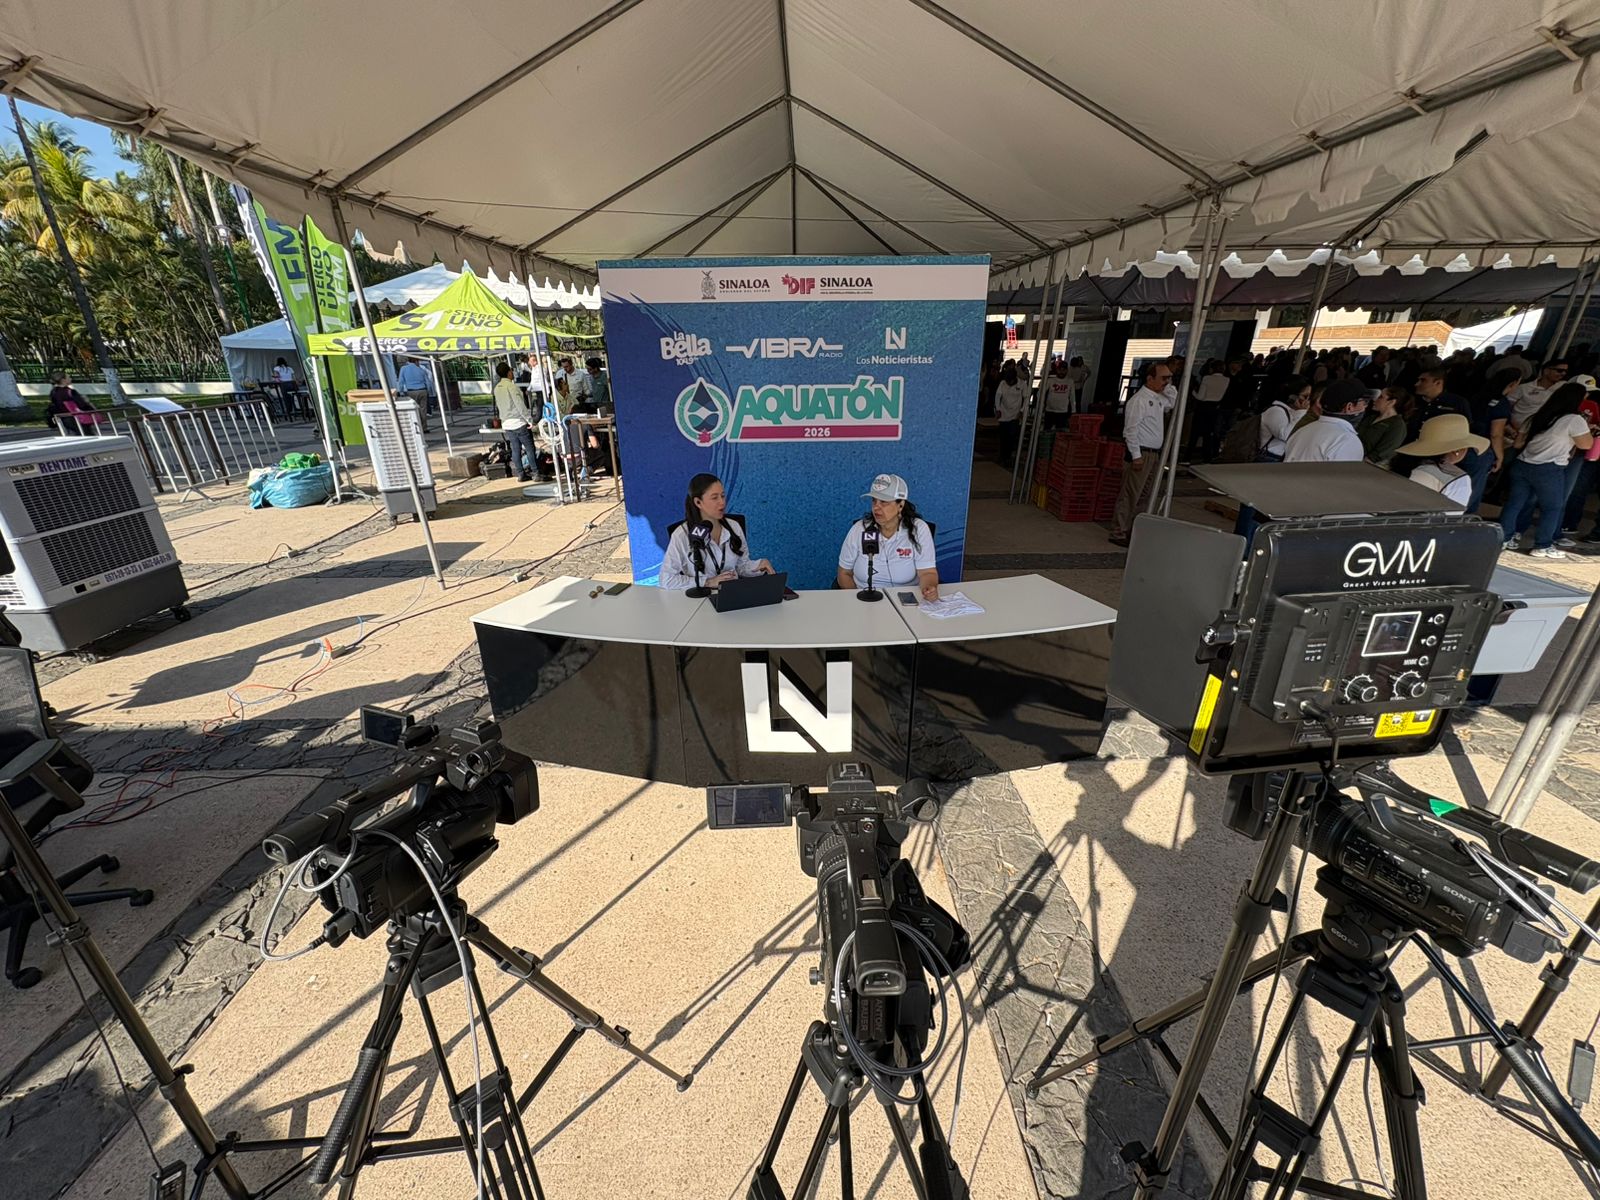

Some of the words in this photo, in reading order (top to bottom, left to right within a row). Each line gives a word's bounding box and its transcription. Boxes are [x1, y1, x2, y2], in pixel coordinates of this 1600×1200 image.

[322, 250, 338, 310] UNO
[719, 279, 770, 289] SINALOA
[787, 277, 816, 295] DIF
[820, 277, 873, 287] SINALOA
[449, 315, 503, 328] UNO
[454, 309, 503, 320] STEREO
[363, 337, 408, 345] SEREO
[660, 333, 712, 360] Bella
[726, 337, 843, 358] VIBRA
[885, 327, 907, 350] LN
[871, 355, 933, 364] Noticieristas
[729, 378, 901, 438] AQUATÓN
[804, 428, 831, 437] 2026
[39, 456, 89, 474] RENTAME
[1342, 538, 1437, 578] GVM
[1442, 885, 1476, 904] SONY
[1435, 904, 1465, 922] 4K
